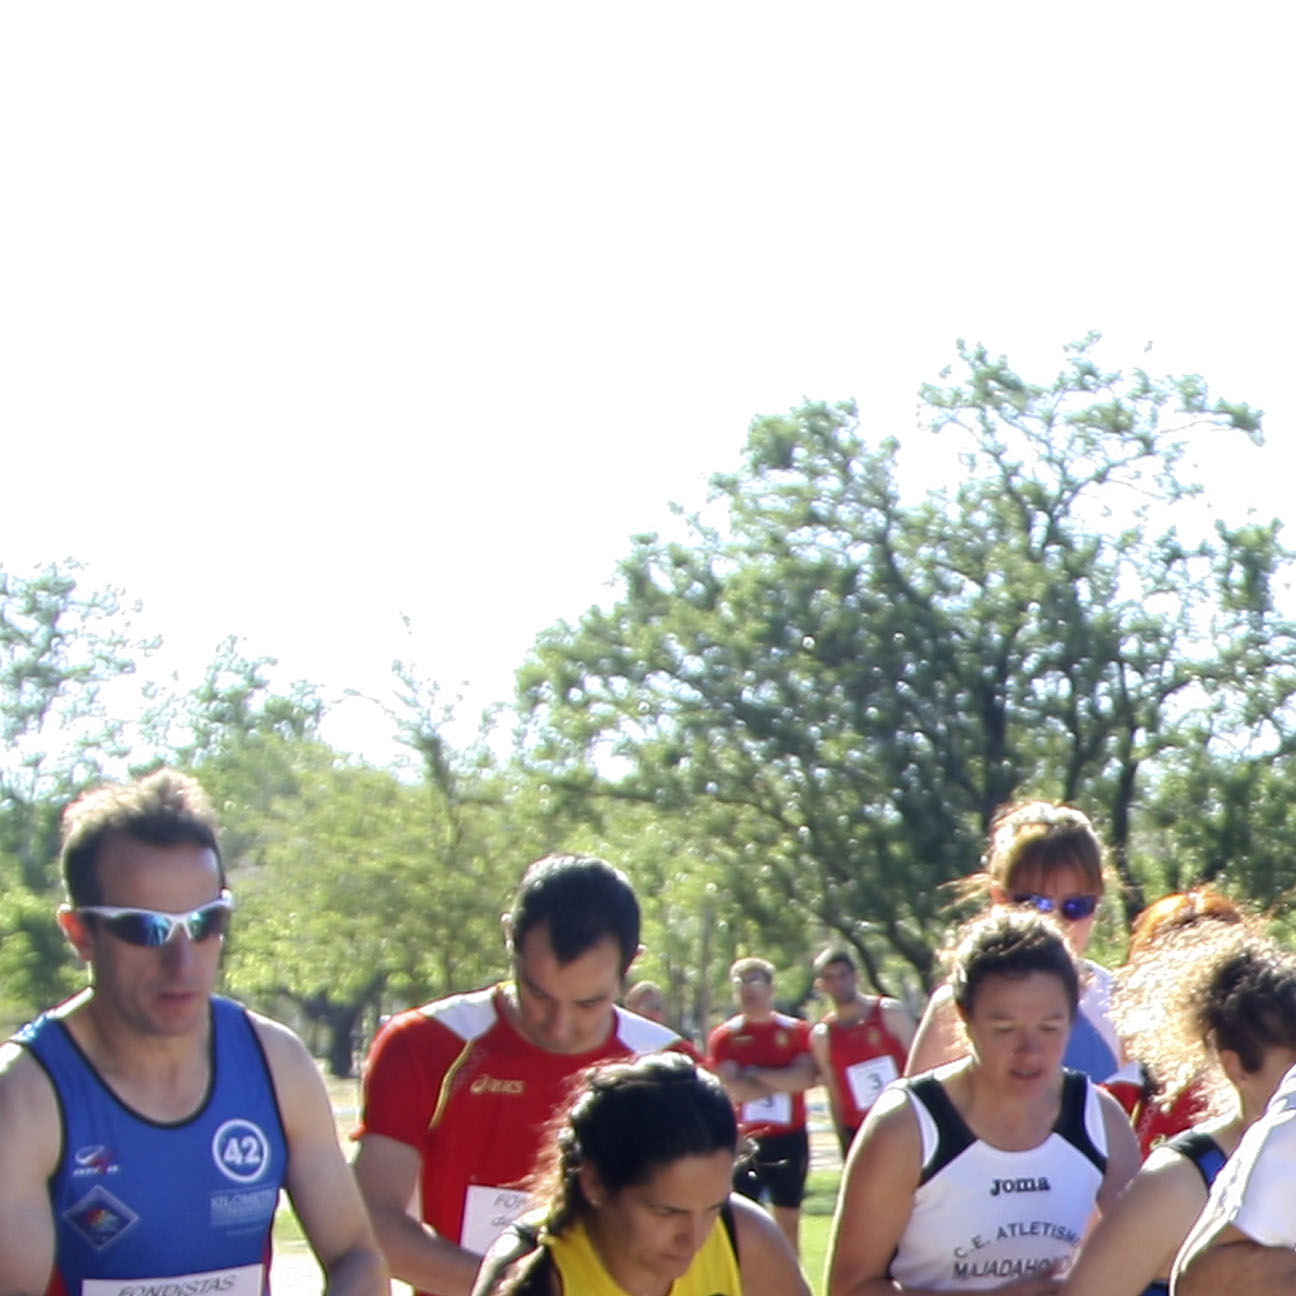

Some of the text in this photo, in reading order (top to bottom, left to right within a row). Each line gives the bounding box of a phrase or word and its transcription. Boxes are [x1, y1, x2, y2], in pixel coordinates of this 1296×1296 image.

[867, 1074, 882, 1090] 3
[223, 1136, 260, 1165] 42
[996, 1221, 1081, 1249] ATLETISM
